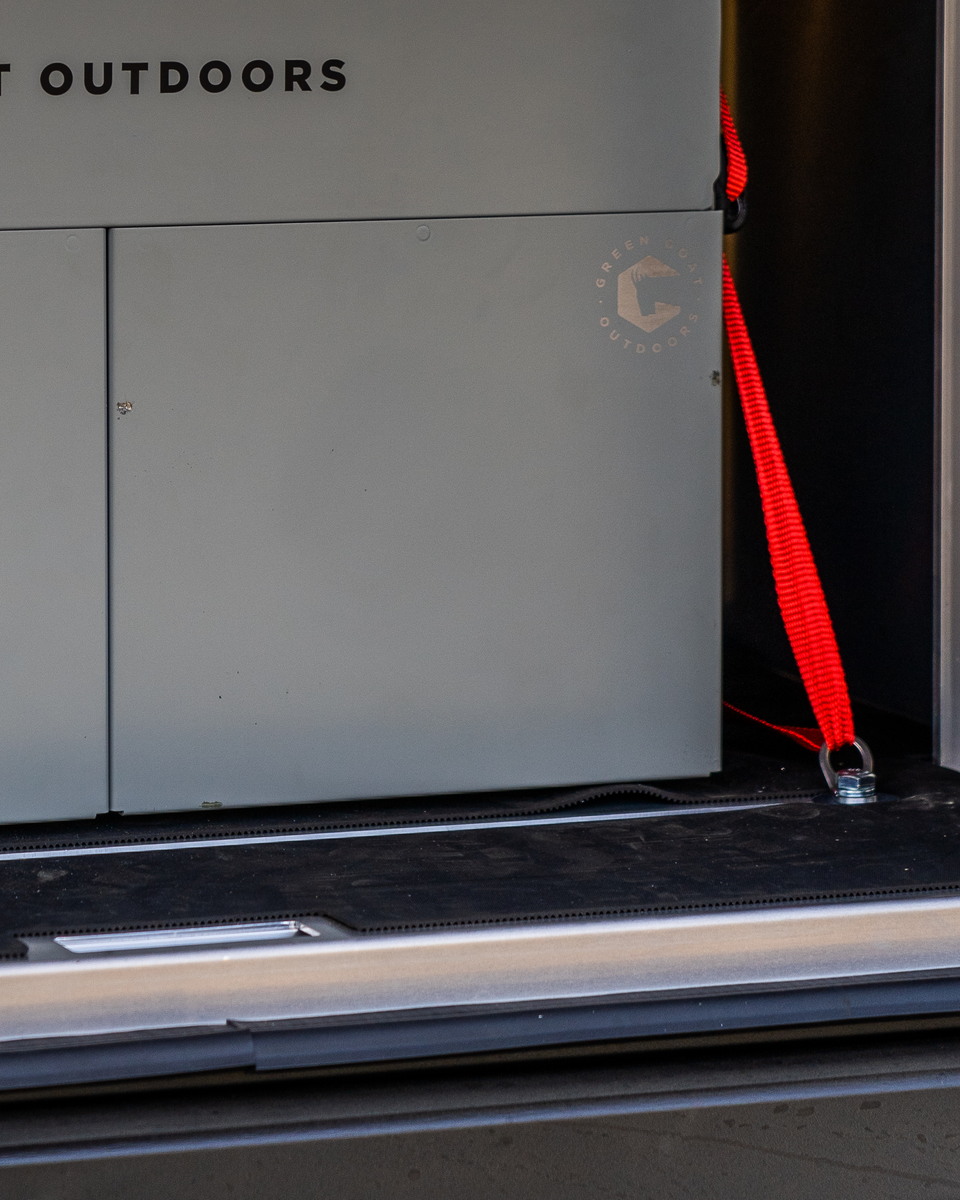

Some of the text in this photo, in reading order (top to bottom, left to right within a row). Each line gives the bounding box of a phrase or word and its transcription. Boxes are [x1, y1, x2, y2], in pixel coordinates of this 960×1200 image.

[40, 59, 346, 95] OUTDOORS
[595, 236, 649, 289] GREEN
[599, 314, 699, 354] OUTDOORS
